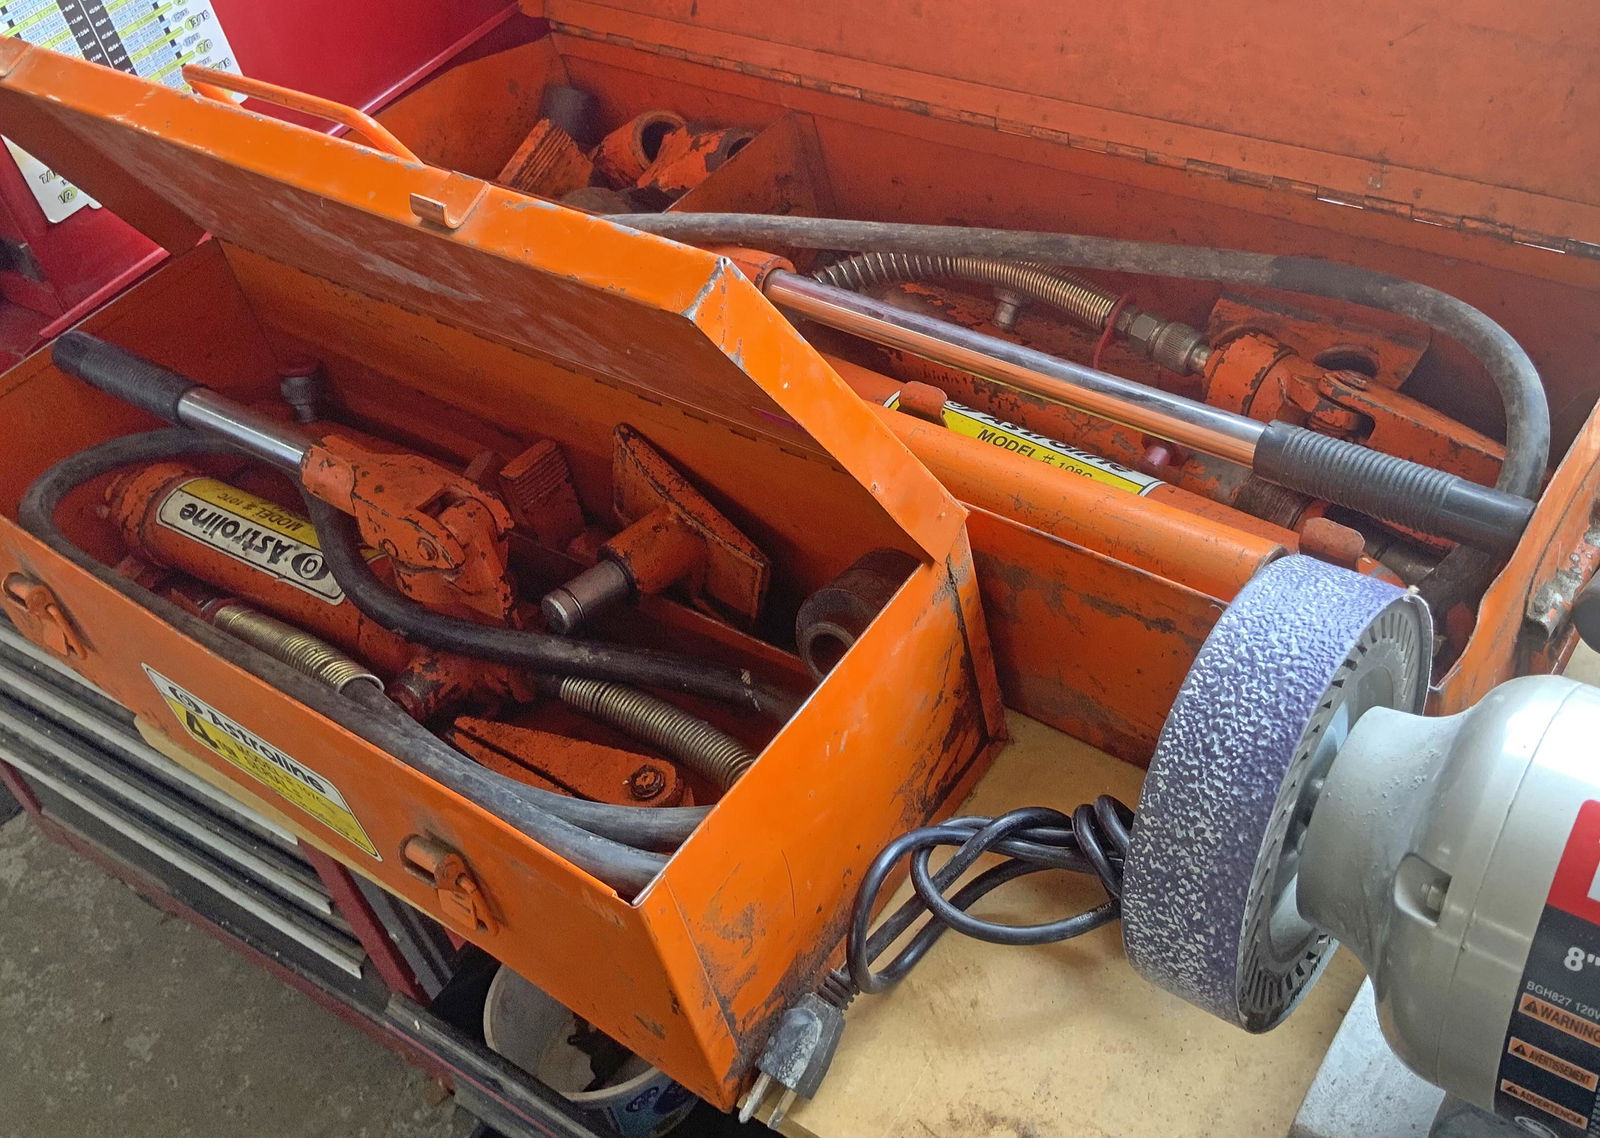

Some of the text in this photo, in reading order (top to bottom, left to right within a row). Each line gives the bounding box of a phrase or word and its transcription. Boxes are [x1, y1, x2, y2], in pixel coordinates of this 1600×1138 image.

[179, 502, 294, 565] Astroline
[208, 709, 327, 795] Astroline
[1526, 980, 1572, 1007] BGH827
[1528, 1050, 1591, 1084] AVERTISSEMENT
